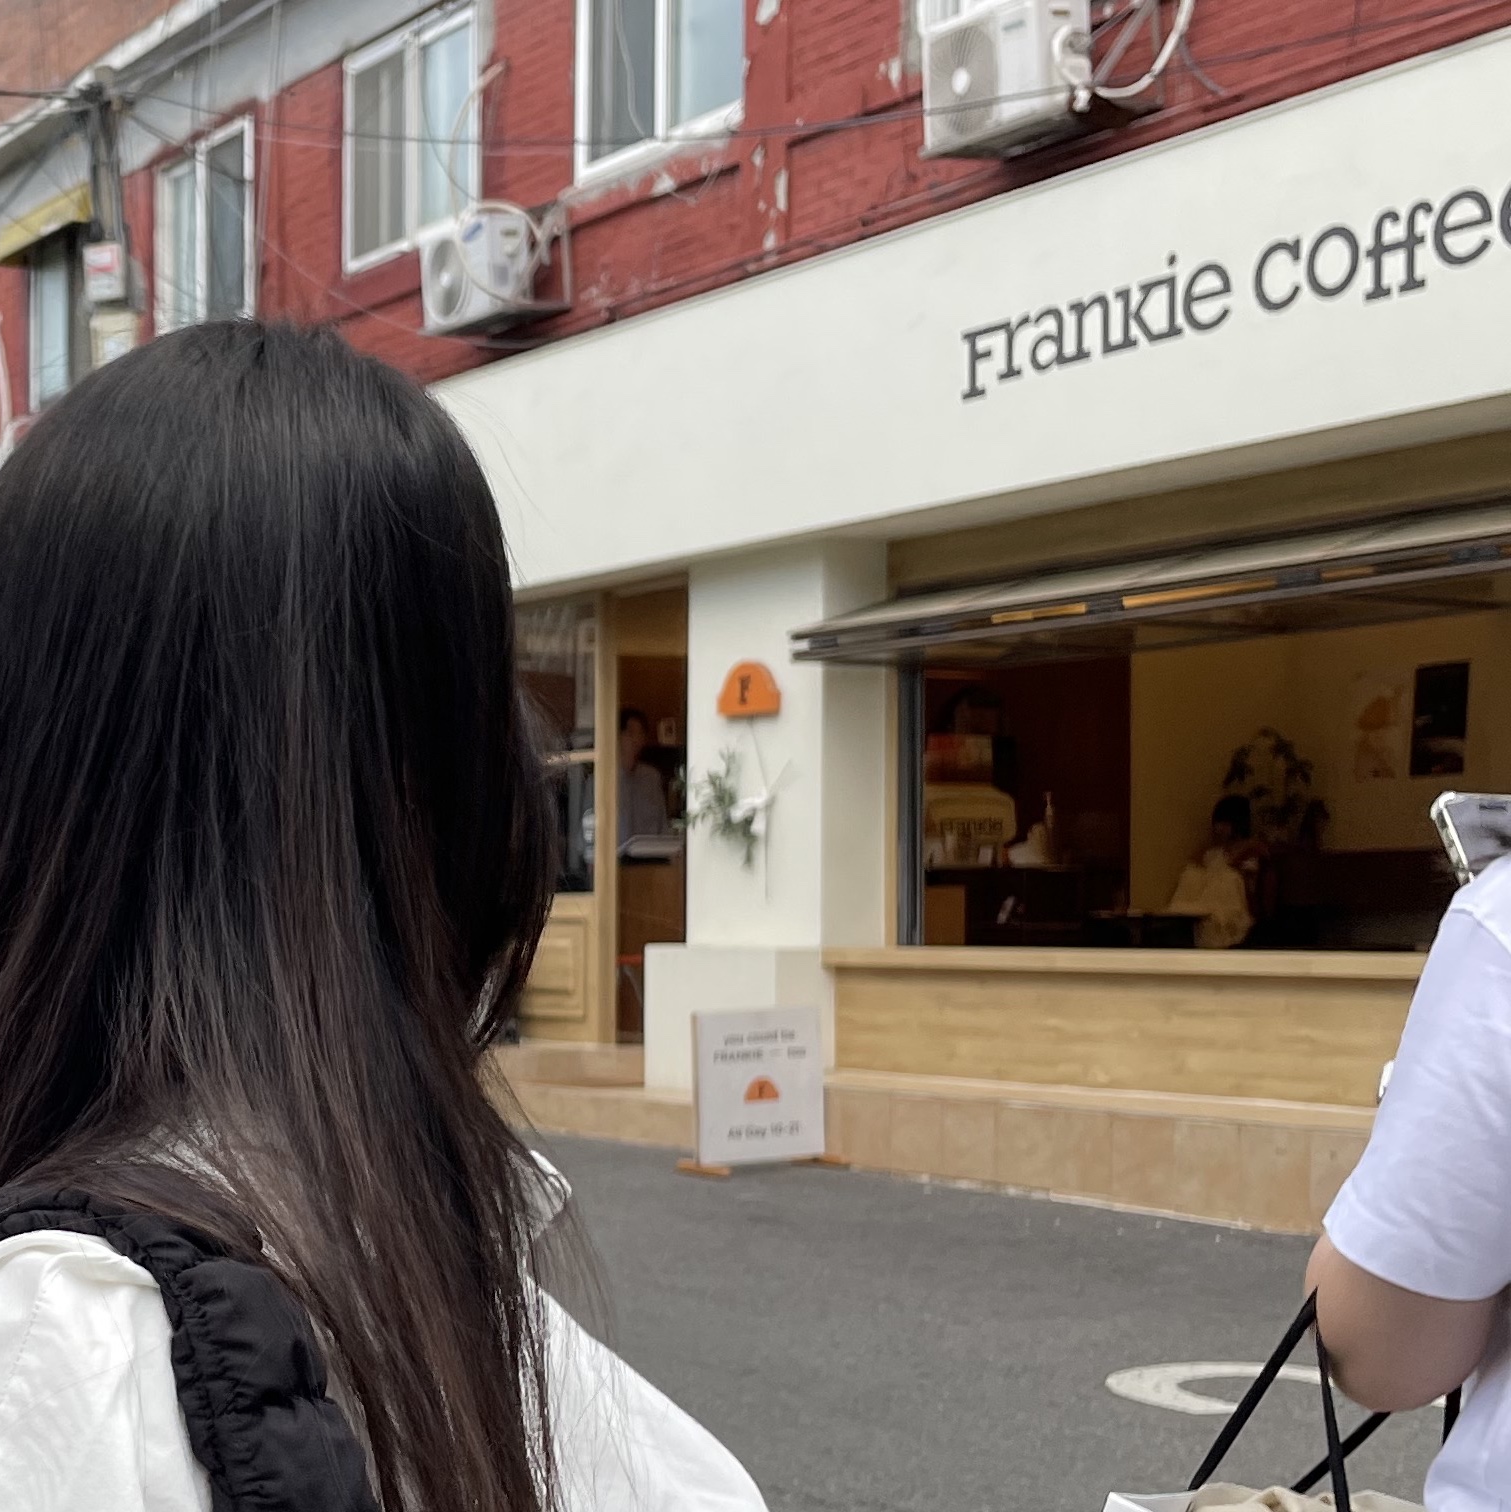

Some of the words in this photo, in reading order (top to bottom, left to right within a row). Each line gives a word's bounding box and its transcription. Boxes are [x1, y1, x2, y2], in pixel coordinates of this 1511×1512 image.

[961, 252, 1233, 401] Frankie
[1254, 187, 1511, 312] coffe
[738, 673, 751, 706] F
